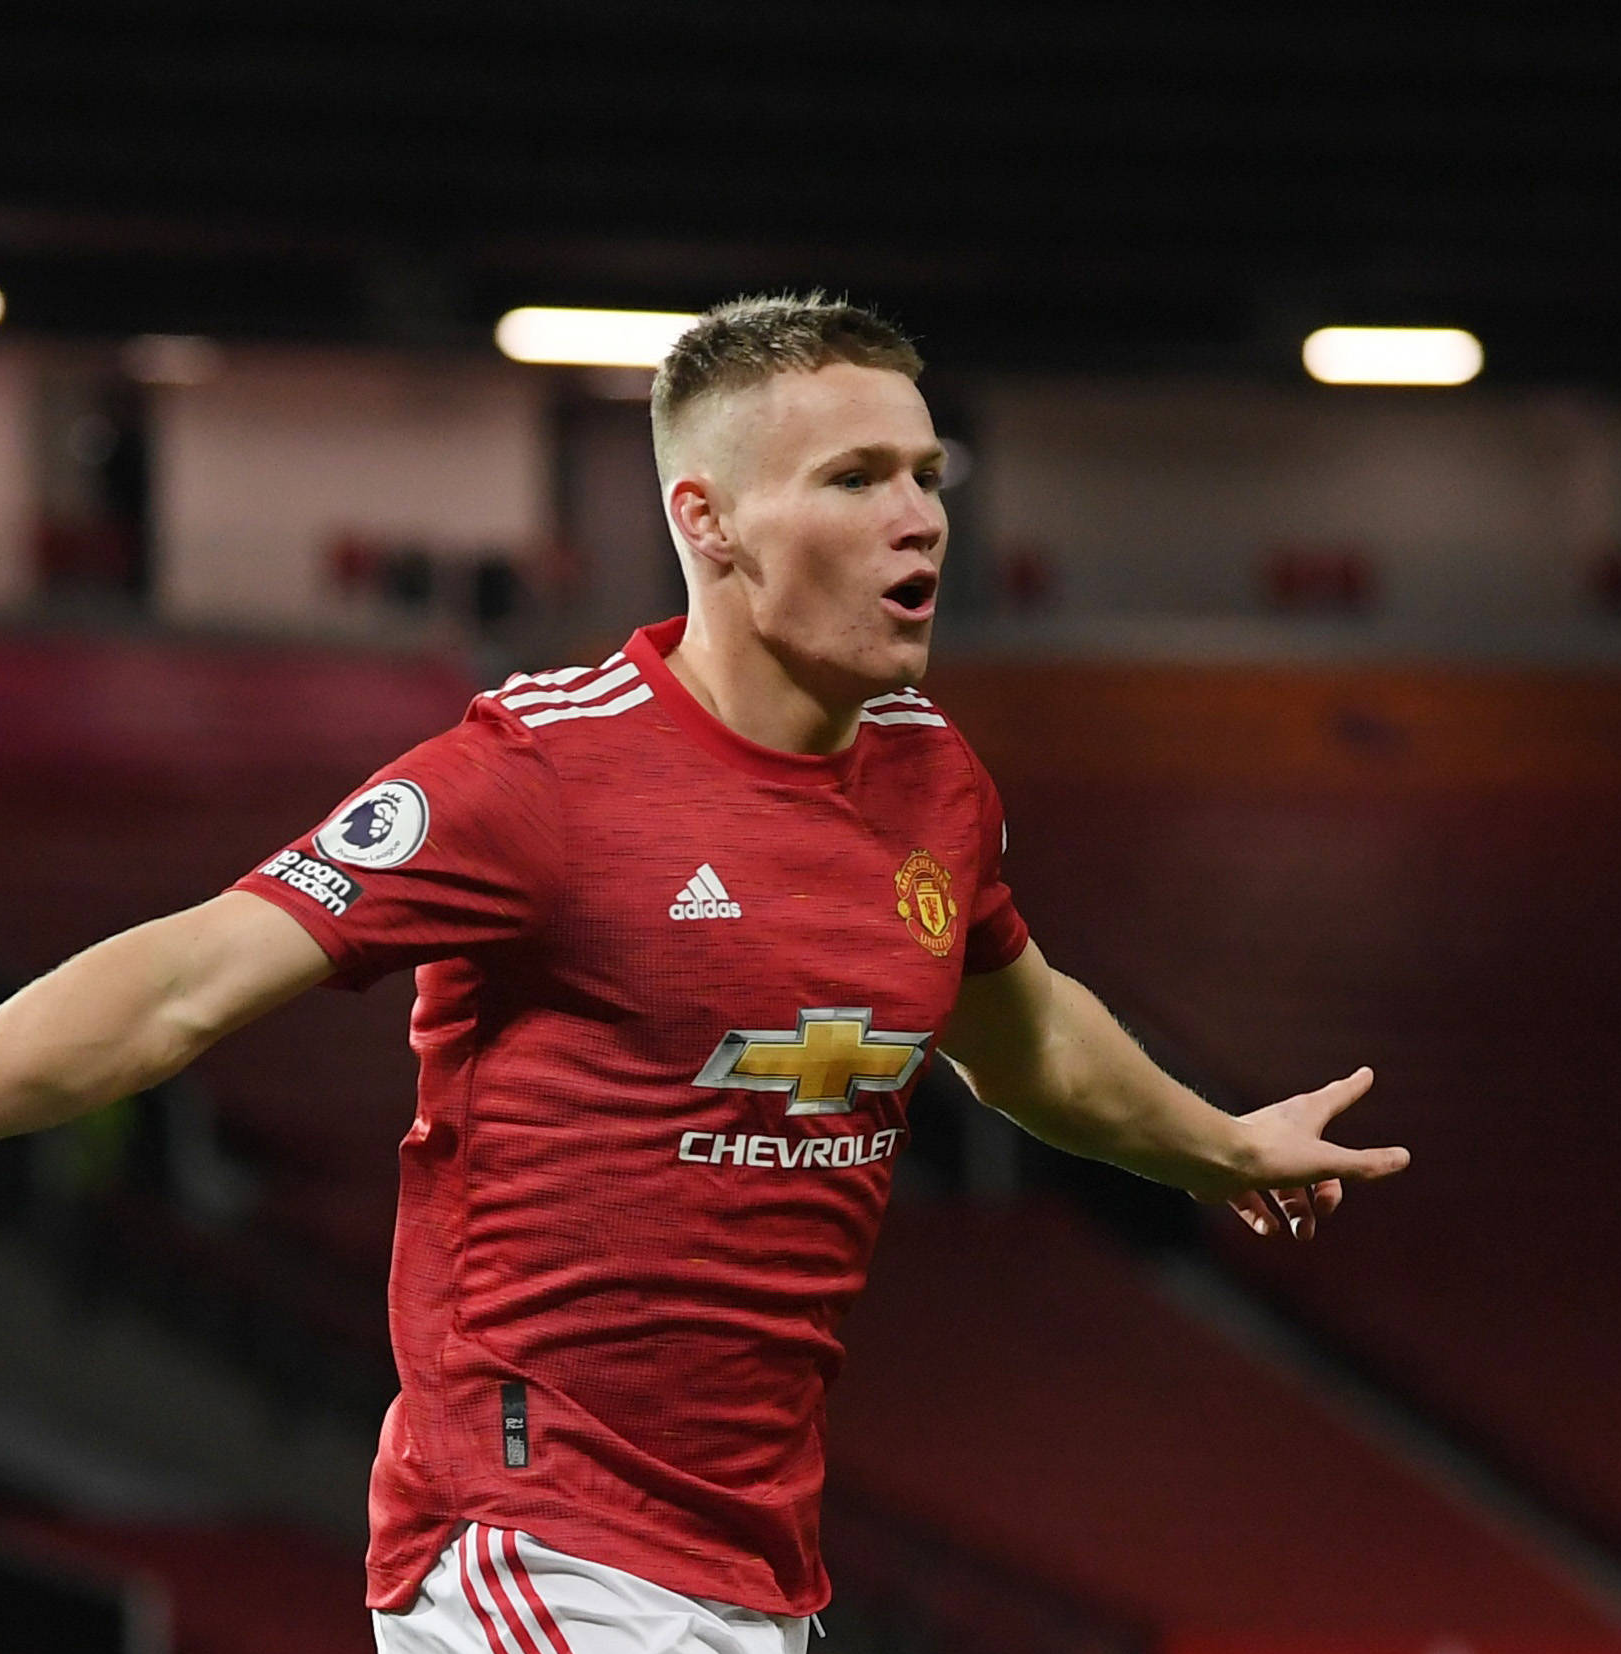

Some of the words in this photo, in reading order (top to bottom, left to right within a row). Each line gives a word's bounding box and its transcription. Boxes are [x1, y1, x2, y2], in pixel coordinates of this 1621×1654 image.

[280, 869, 347, 916] racism
[295, 857, 352, 897] room
[668, 899, 742, 920] adidas
[679, 1128, 906, 1169] CHEVROLET
